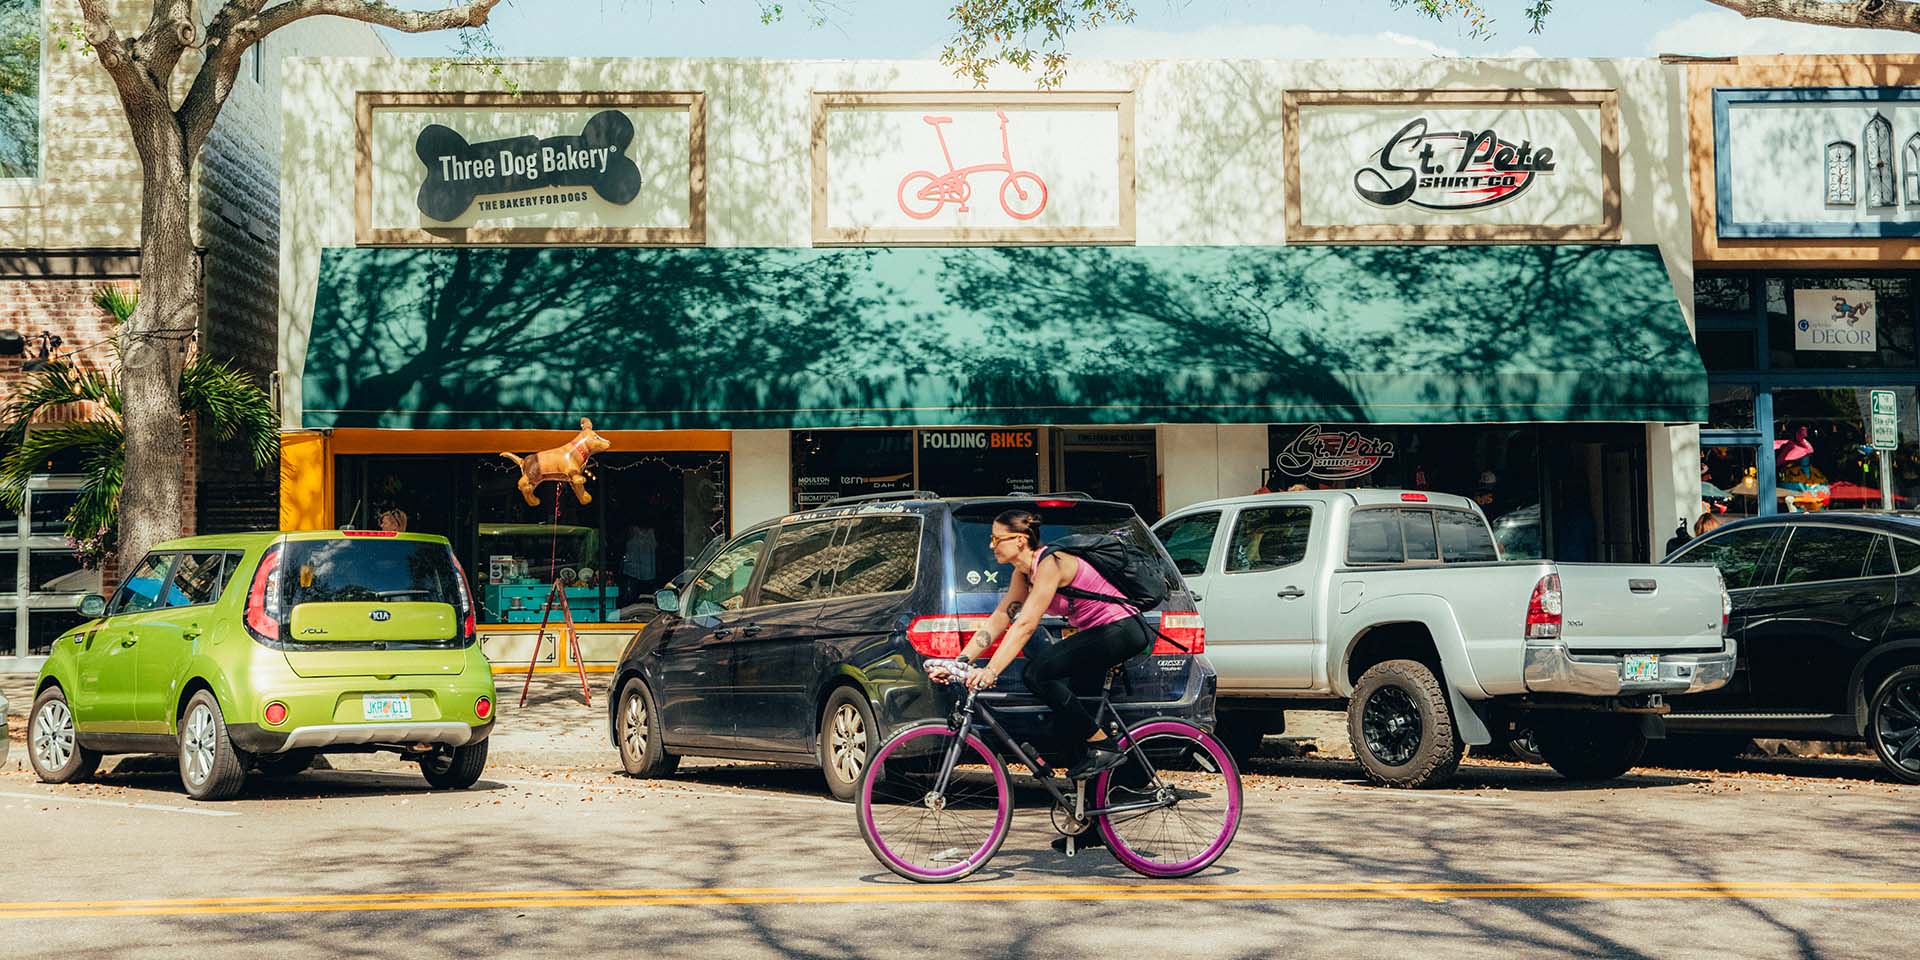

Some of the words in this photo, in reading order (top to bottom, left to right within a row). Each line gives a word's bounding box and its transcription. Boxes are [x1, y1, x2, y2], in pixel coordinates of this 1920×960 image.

[438, 154, 496, 182] Three
[499, 149, 538, 180] Dog
[1354, 117, 1444, 206] St.
[1456, 128, 1556, 173] Pete
[1418, 176, 1484, 188] SHIRT
[479, 200, 498, 211] THE
[499, 196, 538, 209] BAKERY
[539, 194, 559, 205] FOR
[560, 191, 588, 203] DOGS
[1812, 329, 1871, 344] DECOR
[1873, 395, 1879, 412] 2
[922, 432, 987, 449] FOLDING
[991, 432, 1033, 449] BIKES
[1276, 424, 1330, 477] St.
[1336, 431, 1395, 458] Pete
[840, 475, 864, 485] tern
[372, 611, 389, 621] KIA
[392, 700, 408, 714] C11
